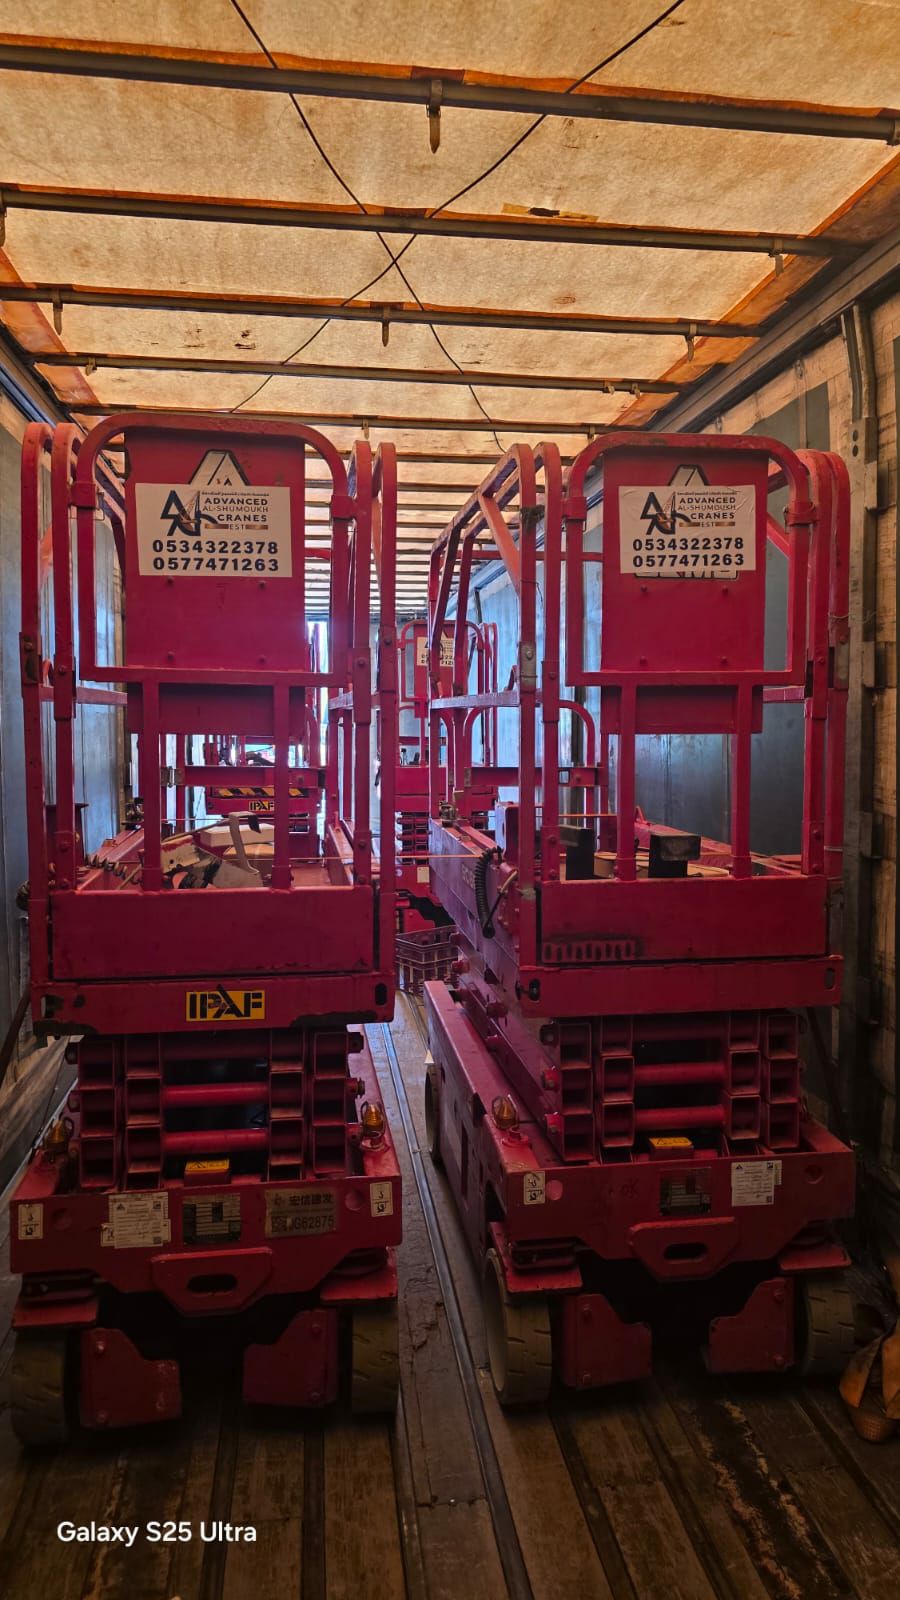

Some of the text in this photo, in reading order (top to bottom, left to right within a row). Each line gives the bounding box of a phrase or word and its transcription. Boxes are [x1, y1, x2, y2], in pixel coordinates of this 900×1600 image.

[204, 497, 268, 506] ADVANCED
[679, 496, 736, 504] ADVANCED
[217, 514, 267, 522] CRANES
[690, 512, 735, 520] CRANES
[152, 539, 278, 555] 0534322378
[632, 537, 744, 551] 0534322378
[153, 557, 279, 572] 0577471263
[632, 553, 744, 568] 0577471263
[250, 800, 274, 812] IPAF
[189, 984, 263, 1019] IPAF
